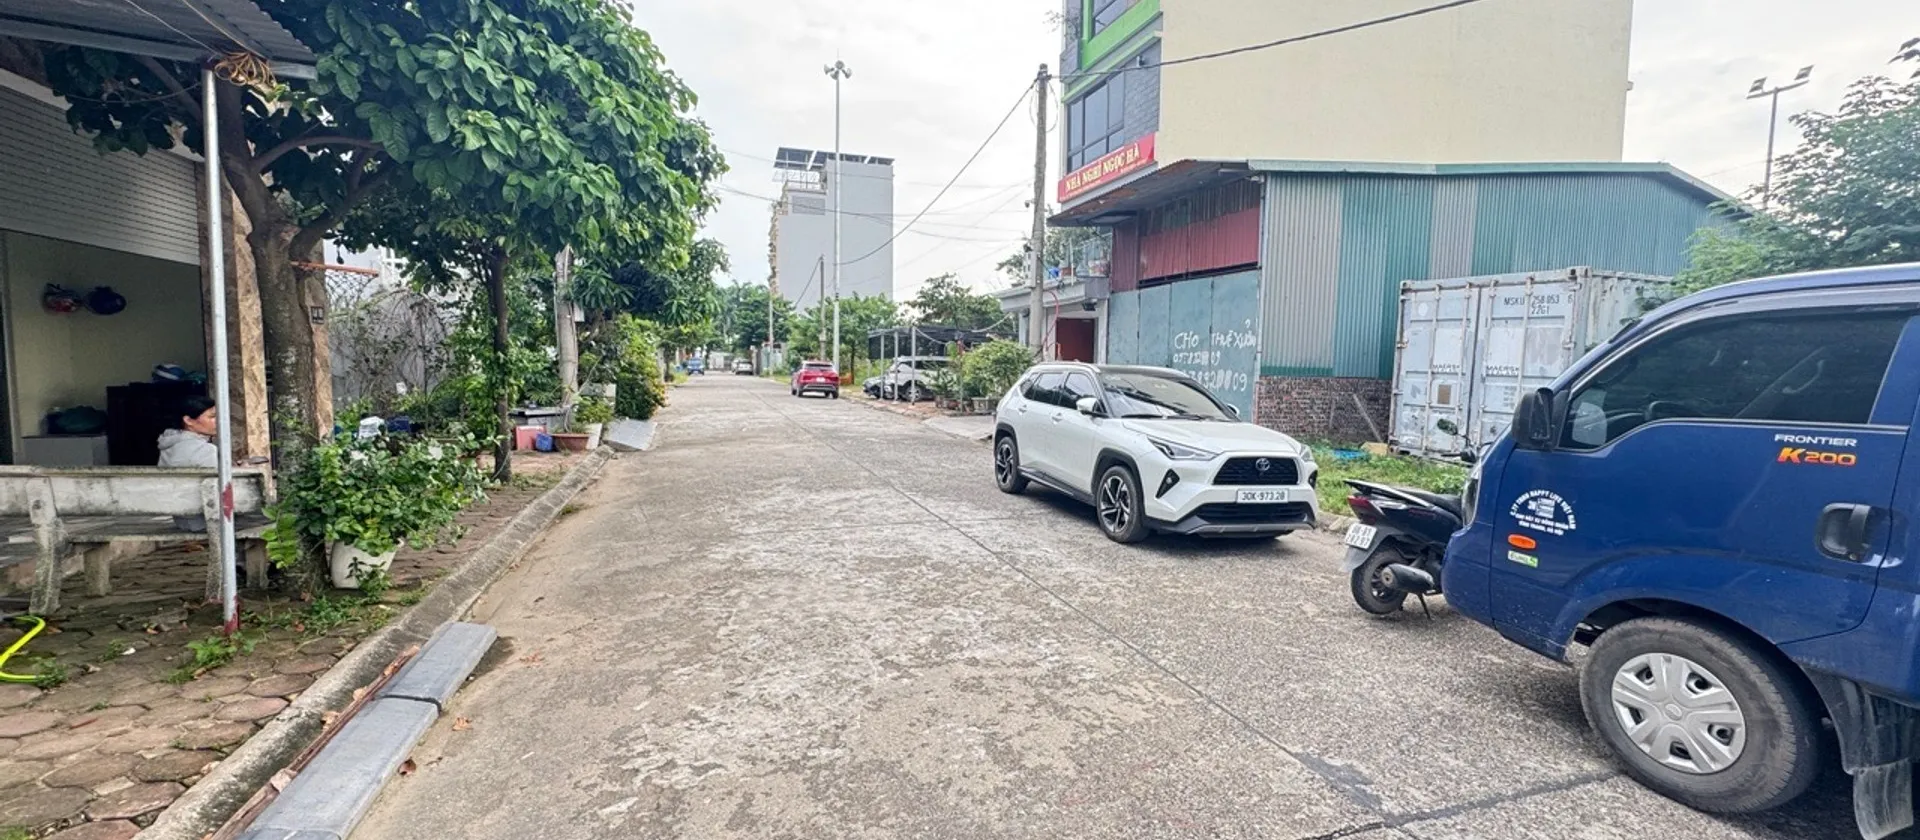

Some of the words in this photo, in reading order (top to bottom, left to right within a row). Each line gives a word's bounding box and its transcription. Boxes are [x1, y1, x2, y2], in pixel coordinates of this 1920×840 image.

[1065, 172, 1081, 191] NHÀ
[1082, 161, 1102, 184] NGHỈ
[1103, 153, 1126, 176] NGỌC
[1126, 142, 1140, 165] HÀ
[1174, 330, 1199, 349] CHO
[1774, 433, 1858, 447] FRONTIER
[1777, 447, 1857, 466] K200
[1530, 489, 1550, 497] HAPPY
